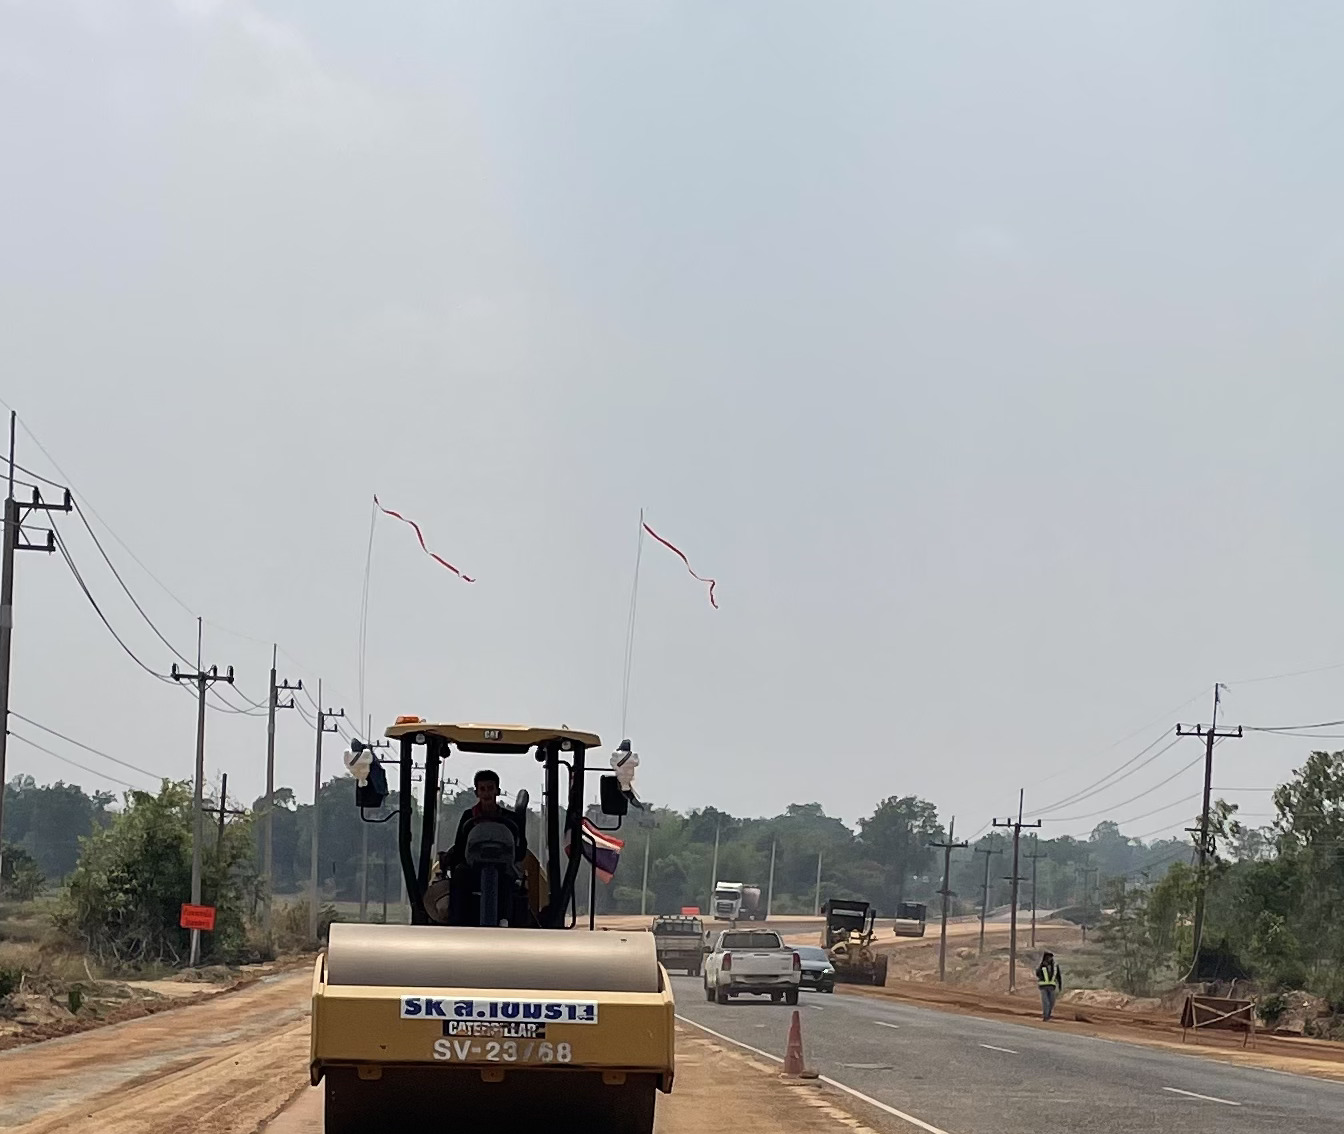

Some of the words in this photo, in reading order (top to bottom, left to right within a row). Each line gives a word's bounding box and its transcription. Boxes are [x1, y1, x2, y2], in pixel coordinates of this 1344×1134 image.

[484, 730, 499, 739] CAT
[404, 997, 446, 1016] SK
[448, 1020, 537, 1038] CATERPILLAR
[433, 1039, 573, 1063] SV-23/68
